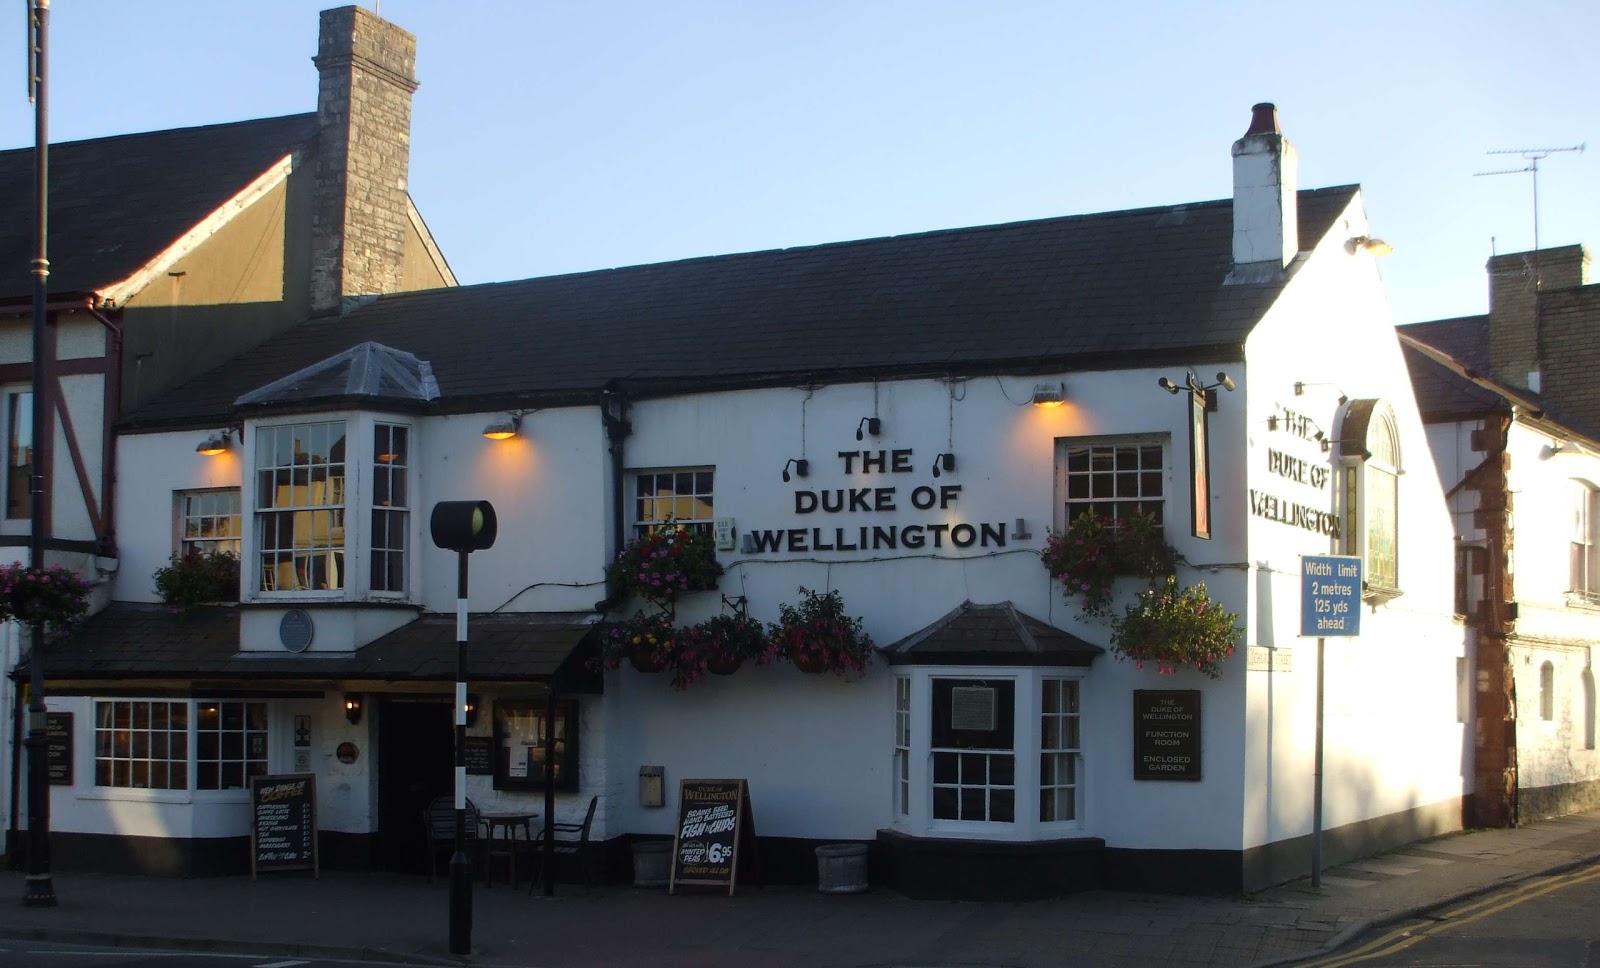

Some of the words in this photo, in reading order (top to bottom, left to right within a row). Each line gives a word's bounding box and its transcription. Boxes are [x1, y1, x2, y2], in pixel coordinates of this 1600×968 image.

[1283, 406, 1312, 442] THE
[838, 448, 913, 474] THE
[1268, 448, 1308, 485] DUKE
[1310, 464, 1330, 490] OF
[795, 487, 896, 514] DUKE
[911, 485, 962, 509] OF
[1250, 488, 1341, 540] WELLINGTON
[751, 522, 1006, 553] WELLINGTON
[1305, 562, 1332, 576] Width
[1338, 563, 1358, 577] limit
[1312, 582, 1319, 595] 2
[1321, 583, 1352, 596] metres
[1314, 598, 1330, 613] 125
[1333, 600, 1348, 616] yds
[1317, 616, 1345, 630] ahead
[1145, 731, 1190, 739] FUNCTION
[1154, 739, 1180, 747] ROOM
[1143, 755, 1191, 763] ENCLOSED
[1148, 764, 1186, 772] GARDEN
[685, 789, 738, 800] WELLINGTON
[680, 822, 707, 839] FISH
[709, 817, 736, 834] CHIPS
[683, 854, 702, 863] PEAS
